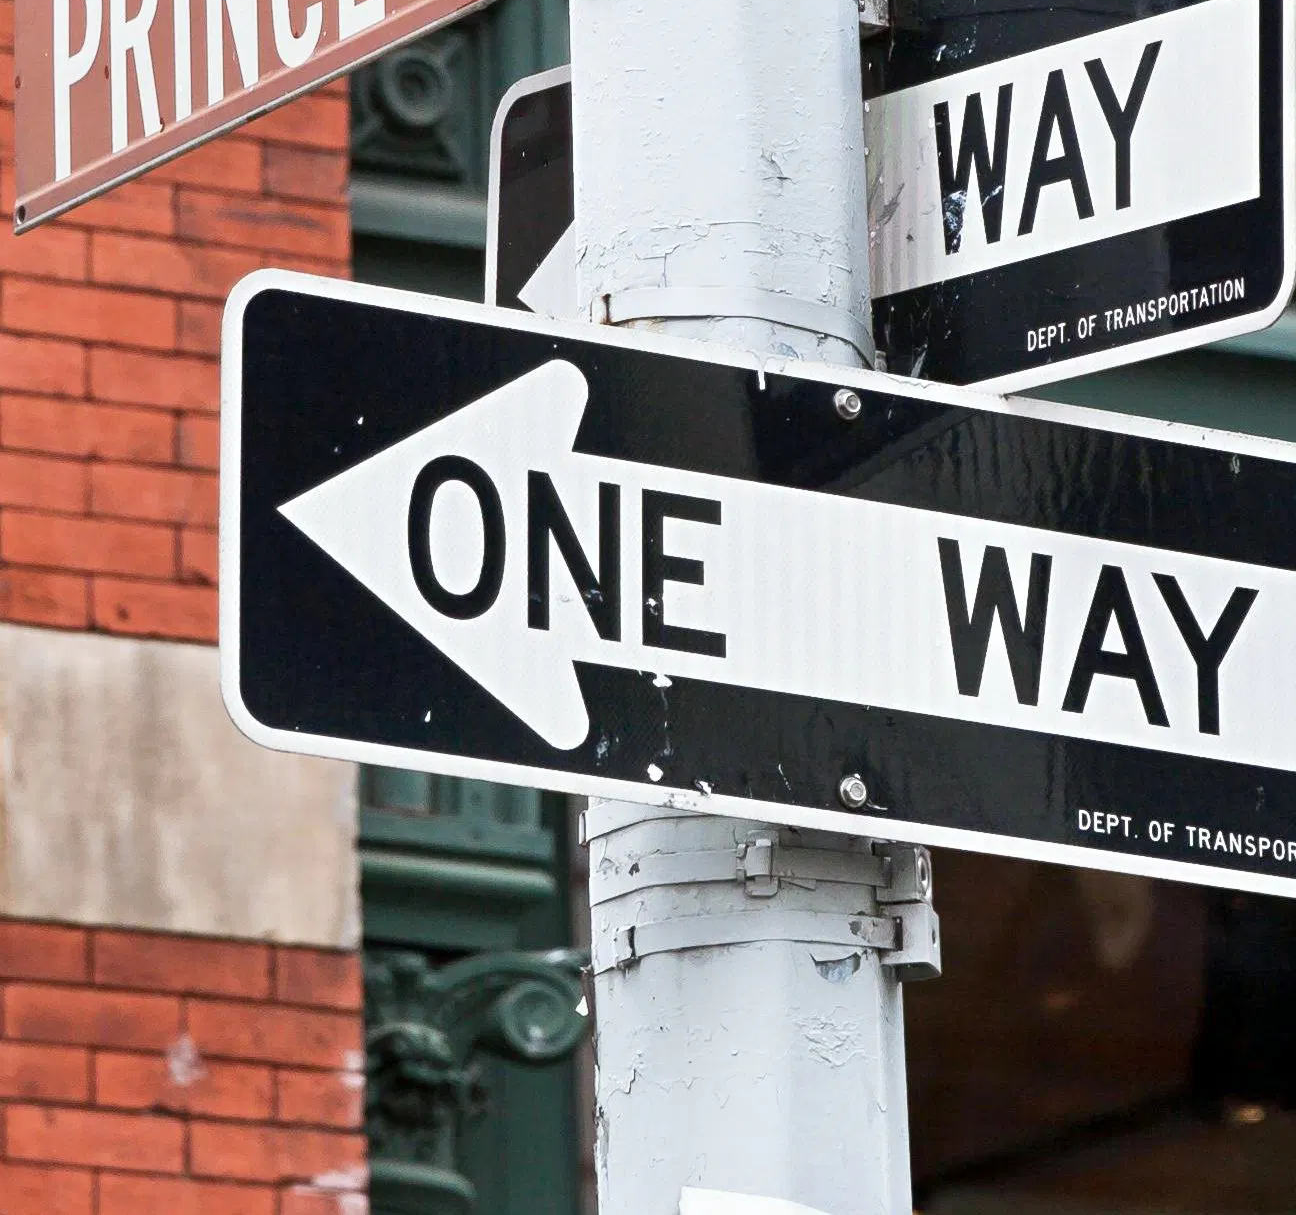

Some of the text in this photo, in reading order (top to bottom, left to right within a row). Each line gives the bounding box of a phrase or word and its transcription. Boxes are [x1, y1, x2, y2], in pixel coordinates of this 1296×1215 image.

[933, 40, 1162, 256] WAY
[1027, 277, 1246, 352] DEPT. OF TRANSPORTATION
[408, 454, 1260, 736] ONE WAY
[1078, 809, 1138, 839] DEPT.
[1148, 820, 1175, 843] OF
